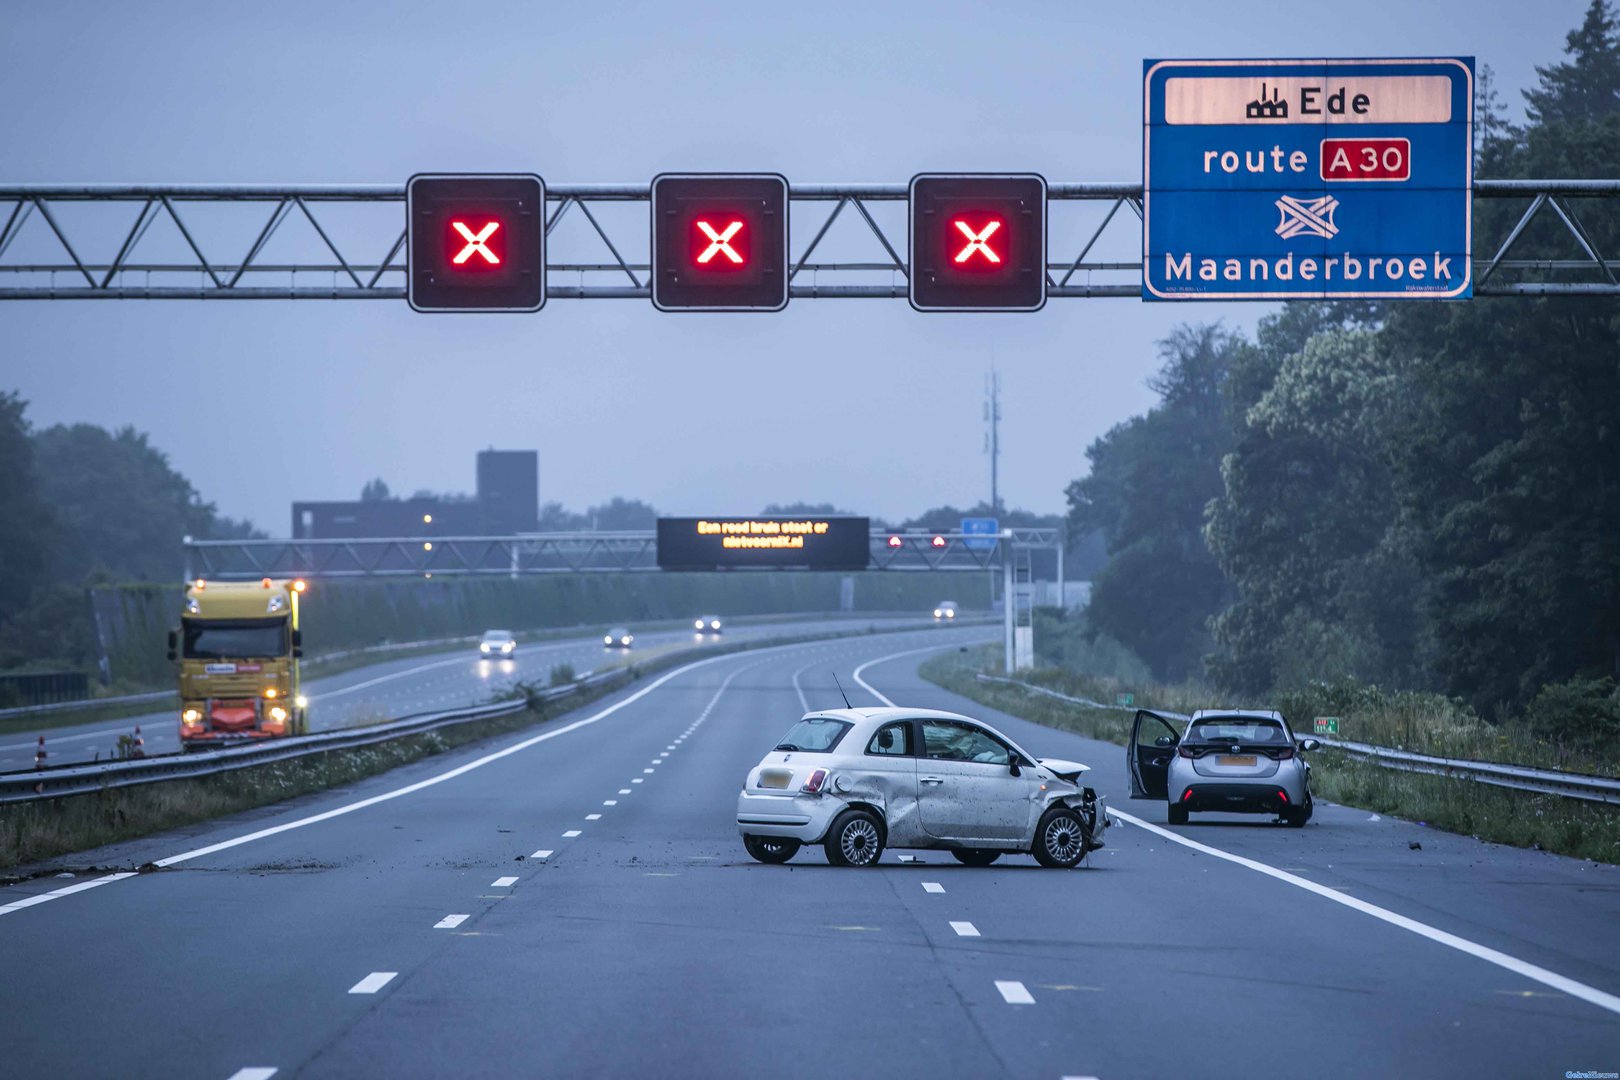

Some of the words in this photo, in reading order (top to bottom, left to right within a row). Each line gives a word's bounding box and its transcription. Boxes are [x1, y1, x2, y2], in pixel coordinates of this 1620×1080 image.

[1300, 87, 1370, 114] Ede
[1204, 145, 1308, 173] route
[1329, 147, 1403, 172] A30
[1165, 251, 1452, 281] Maanderbroek
